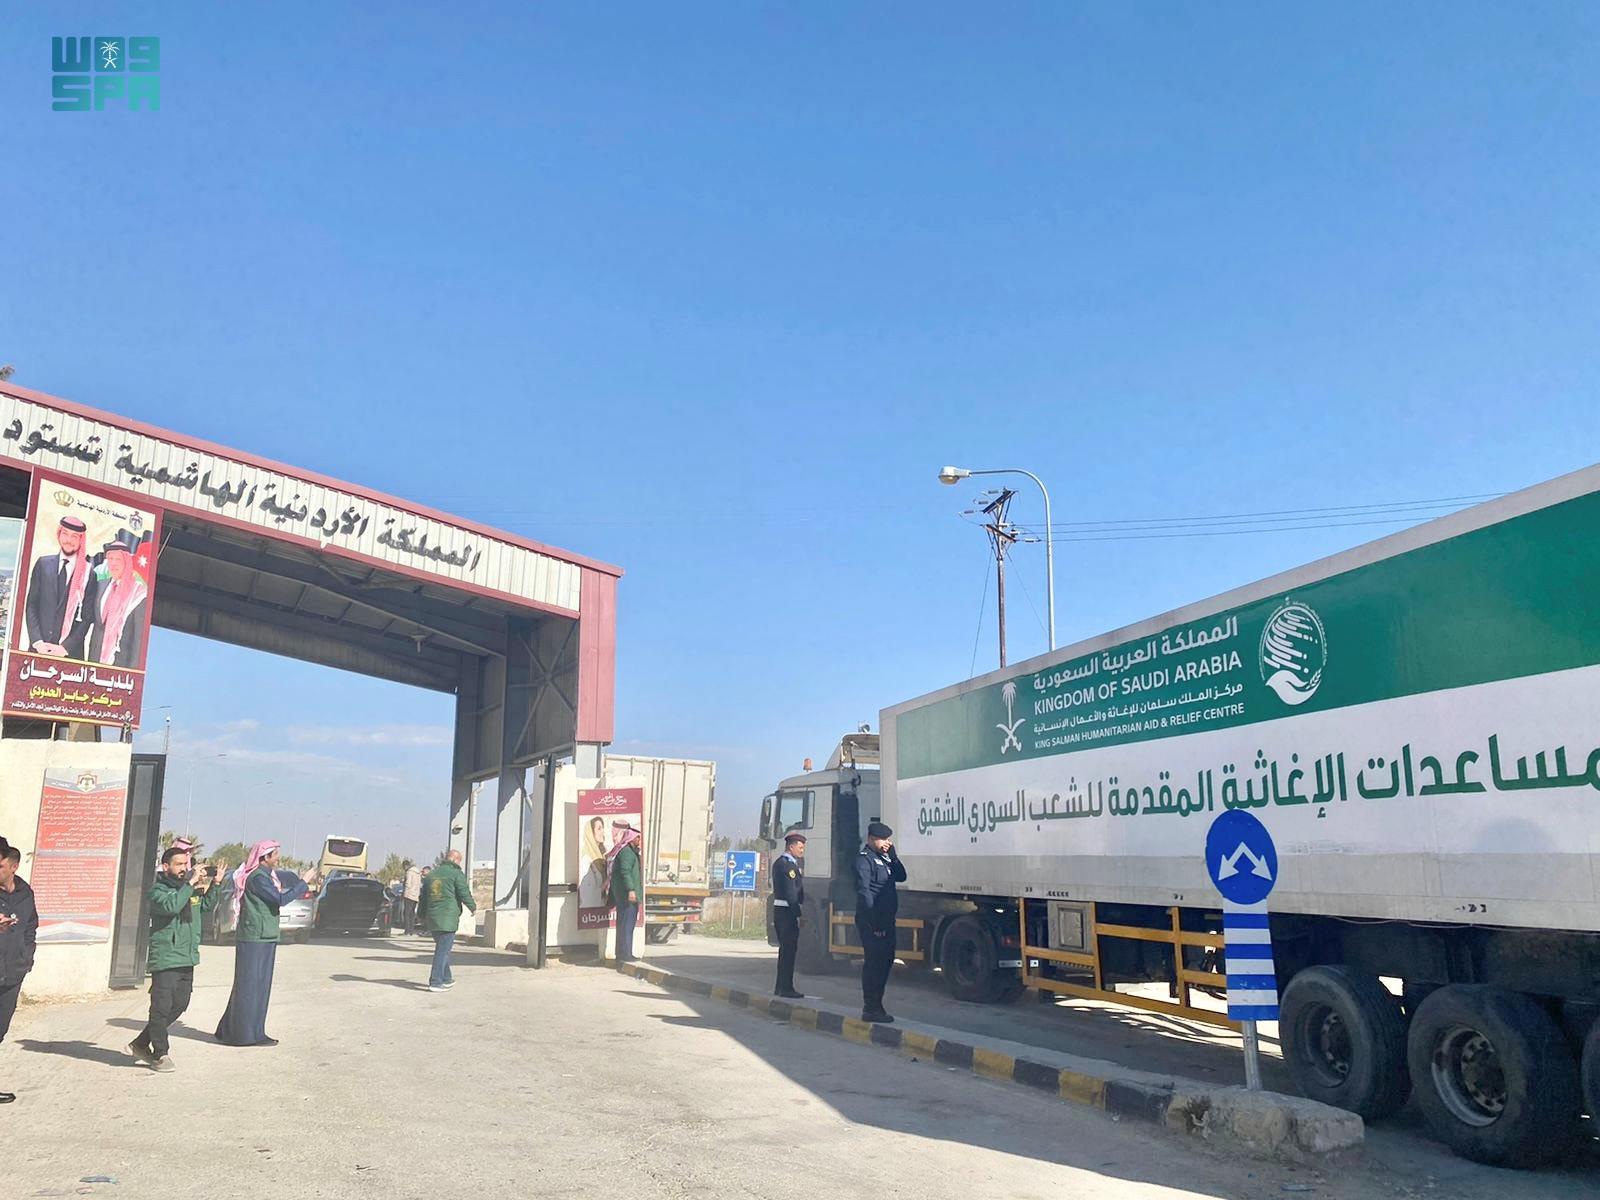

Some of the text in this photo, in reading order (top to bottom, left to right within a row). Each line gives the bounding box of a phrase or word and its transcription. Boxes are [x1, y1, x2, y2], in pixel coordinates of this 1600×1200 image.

[114, 444, 258, 508] الهاشمية
[259, 482, 371, 539] الأردنية
[376, 517, 482, 572] المملكة
[19, 658, 135, 695] بلدية السرحان
[1033, 615, 1239, 694] المملكة العربية السعودية
[29, 684, 123, 708] مركز جابر الحدودي
[1033, 683, 1243, 735] مركز الملك سلمان للإغاثة والأعمال الإنسانية
[1034, 650, 1243, 716] KINGDOM OF SAUDI ARABIA
[1035, 702, 1245, 749] KING SALMAN HUMANITARIAN AID & RELIEF CENTRE
[917, 792, 965, 836] الشقيق
[967, 789, 1026, 843] السوري
[1028, 776, 1103, 832] للشعب
[1108, 769, 1213, 817] المقدمة
[582, 911, 616, 924] السرحان
